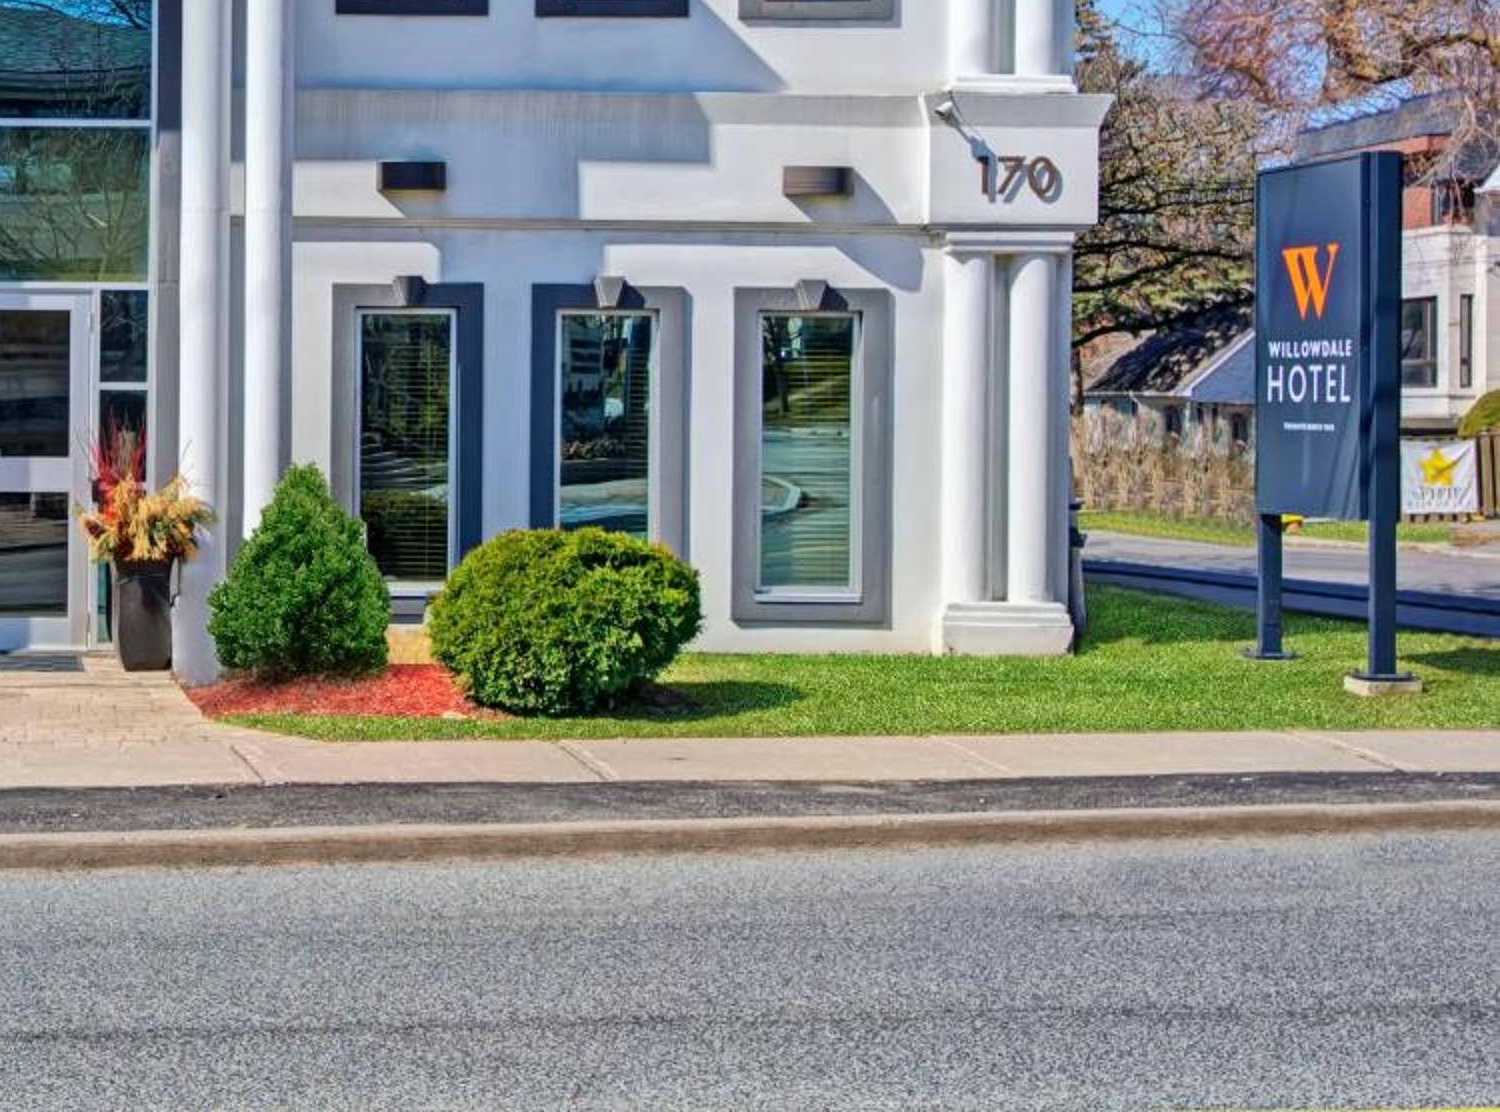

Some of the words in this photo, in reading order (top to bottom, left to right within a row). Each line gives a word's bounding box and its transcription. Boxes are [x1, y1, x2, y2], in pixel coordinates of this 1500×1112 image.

[977, 155, 1056, 196] 170
[1282, 243, 1339, 320] W
[1268, 339, 1352, 358] WILLOWDALE
[1267, 364, 1351, 403] HOTEL
